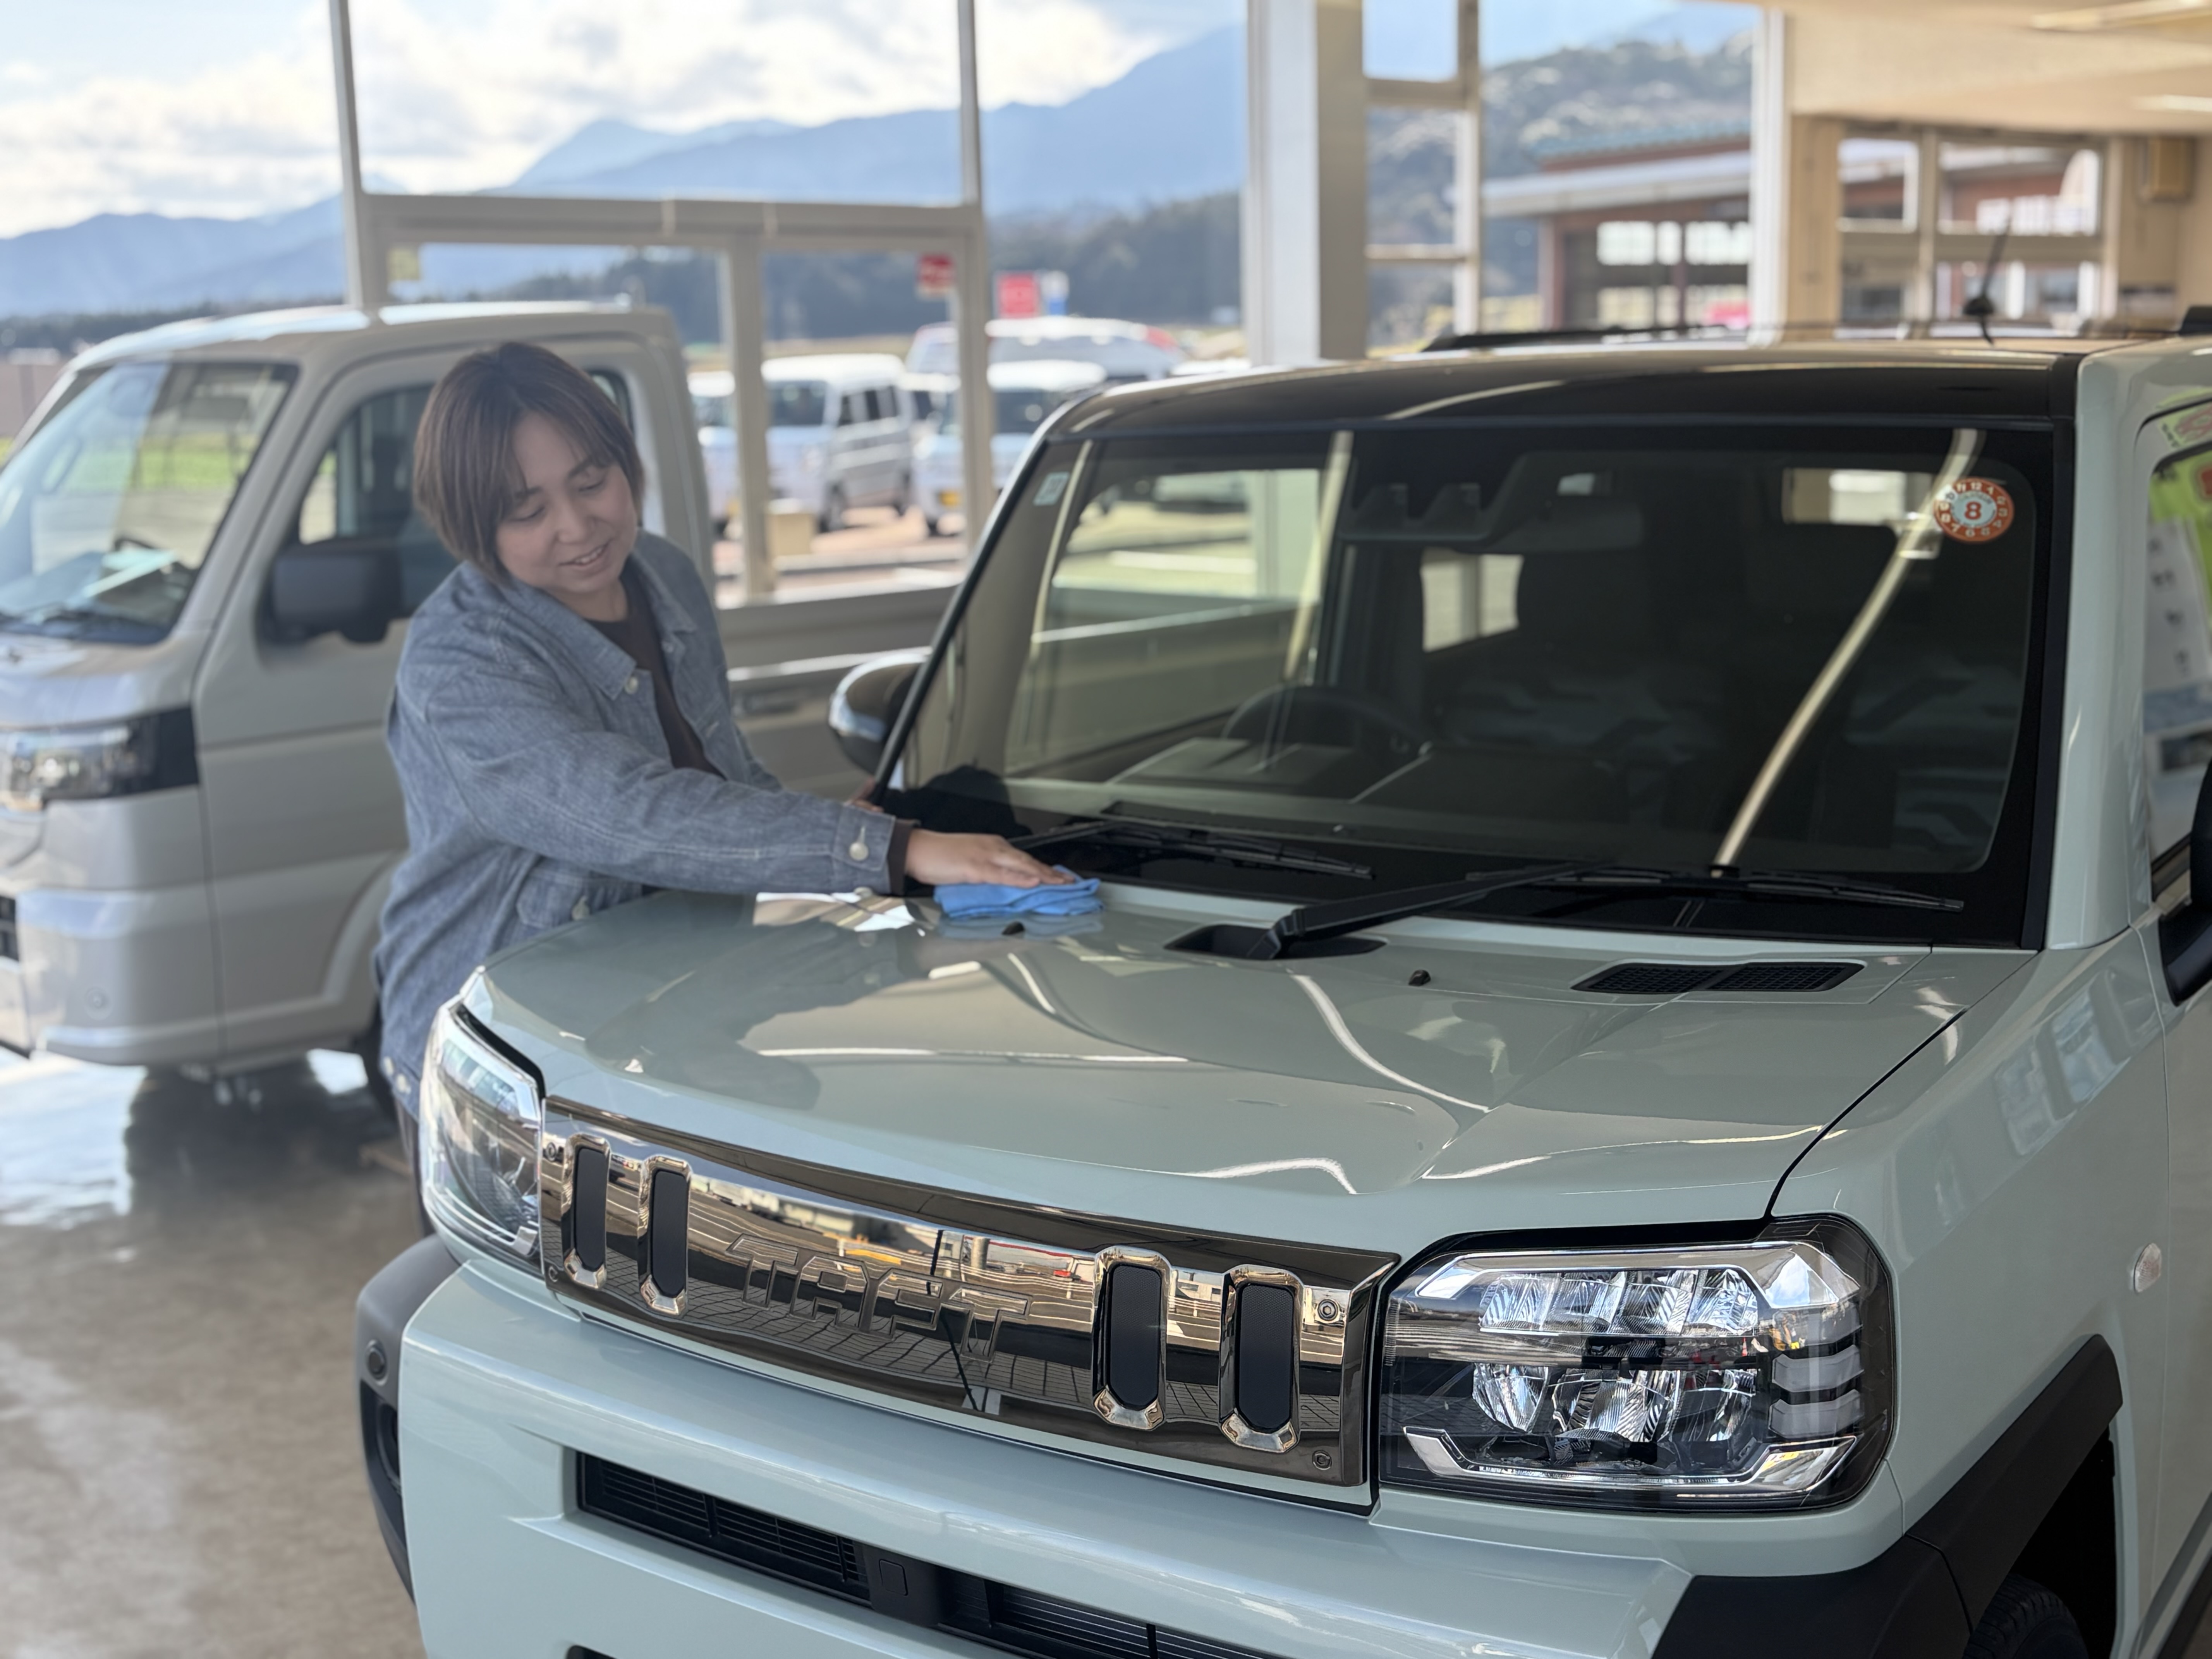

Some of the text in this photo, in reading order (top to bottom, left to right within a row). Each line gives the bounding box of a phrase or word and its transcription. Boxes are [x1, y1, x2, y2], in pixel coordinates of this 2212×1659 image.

[1970, 481, 1982, 490] 12
[1964, 501, 1982, 520] 8
[725, 1233, 1032, 1362] TAFT
